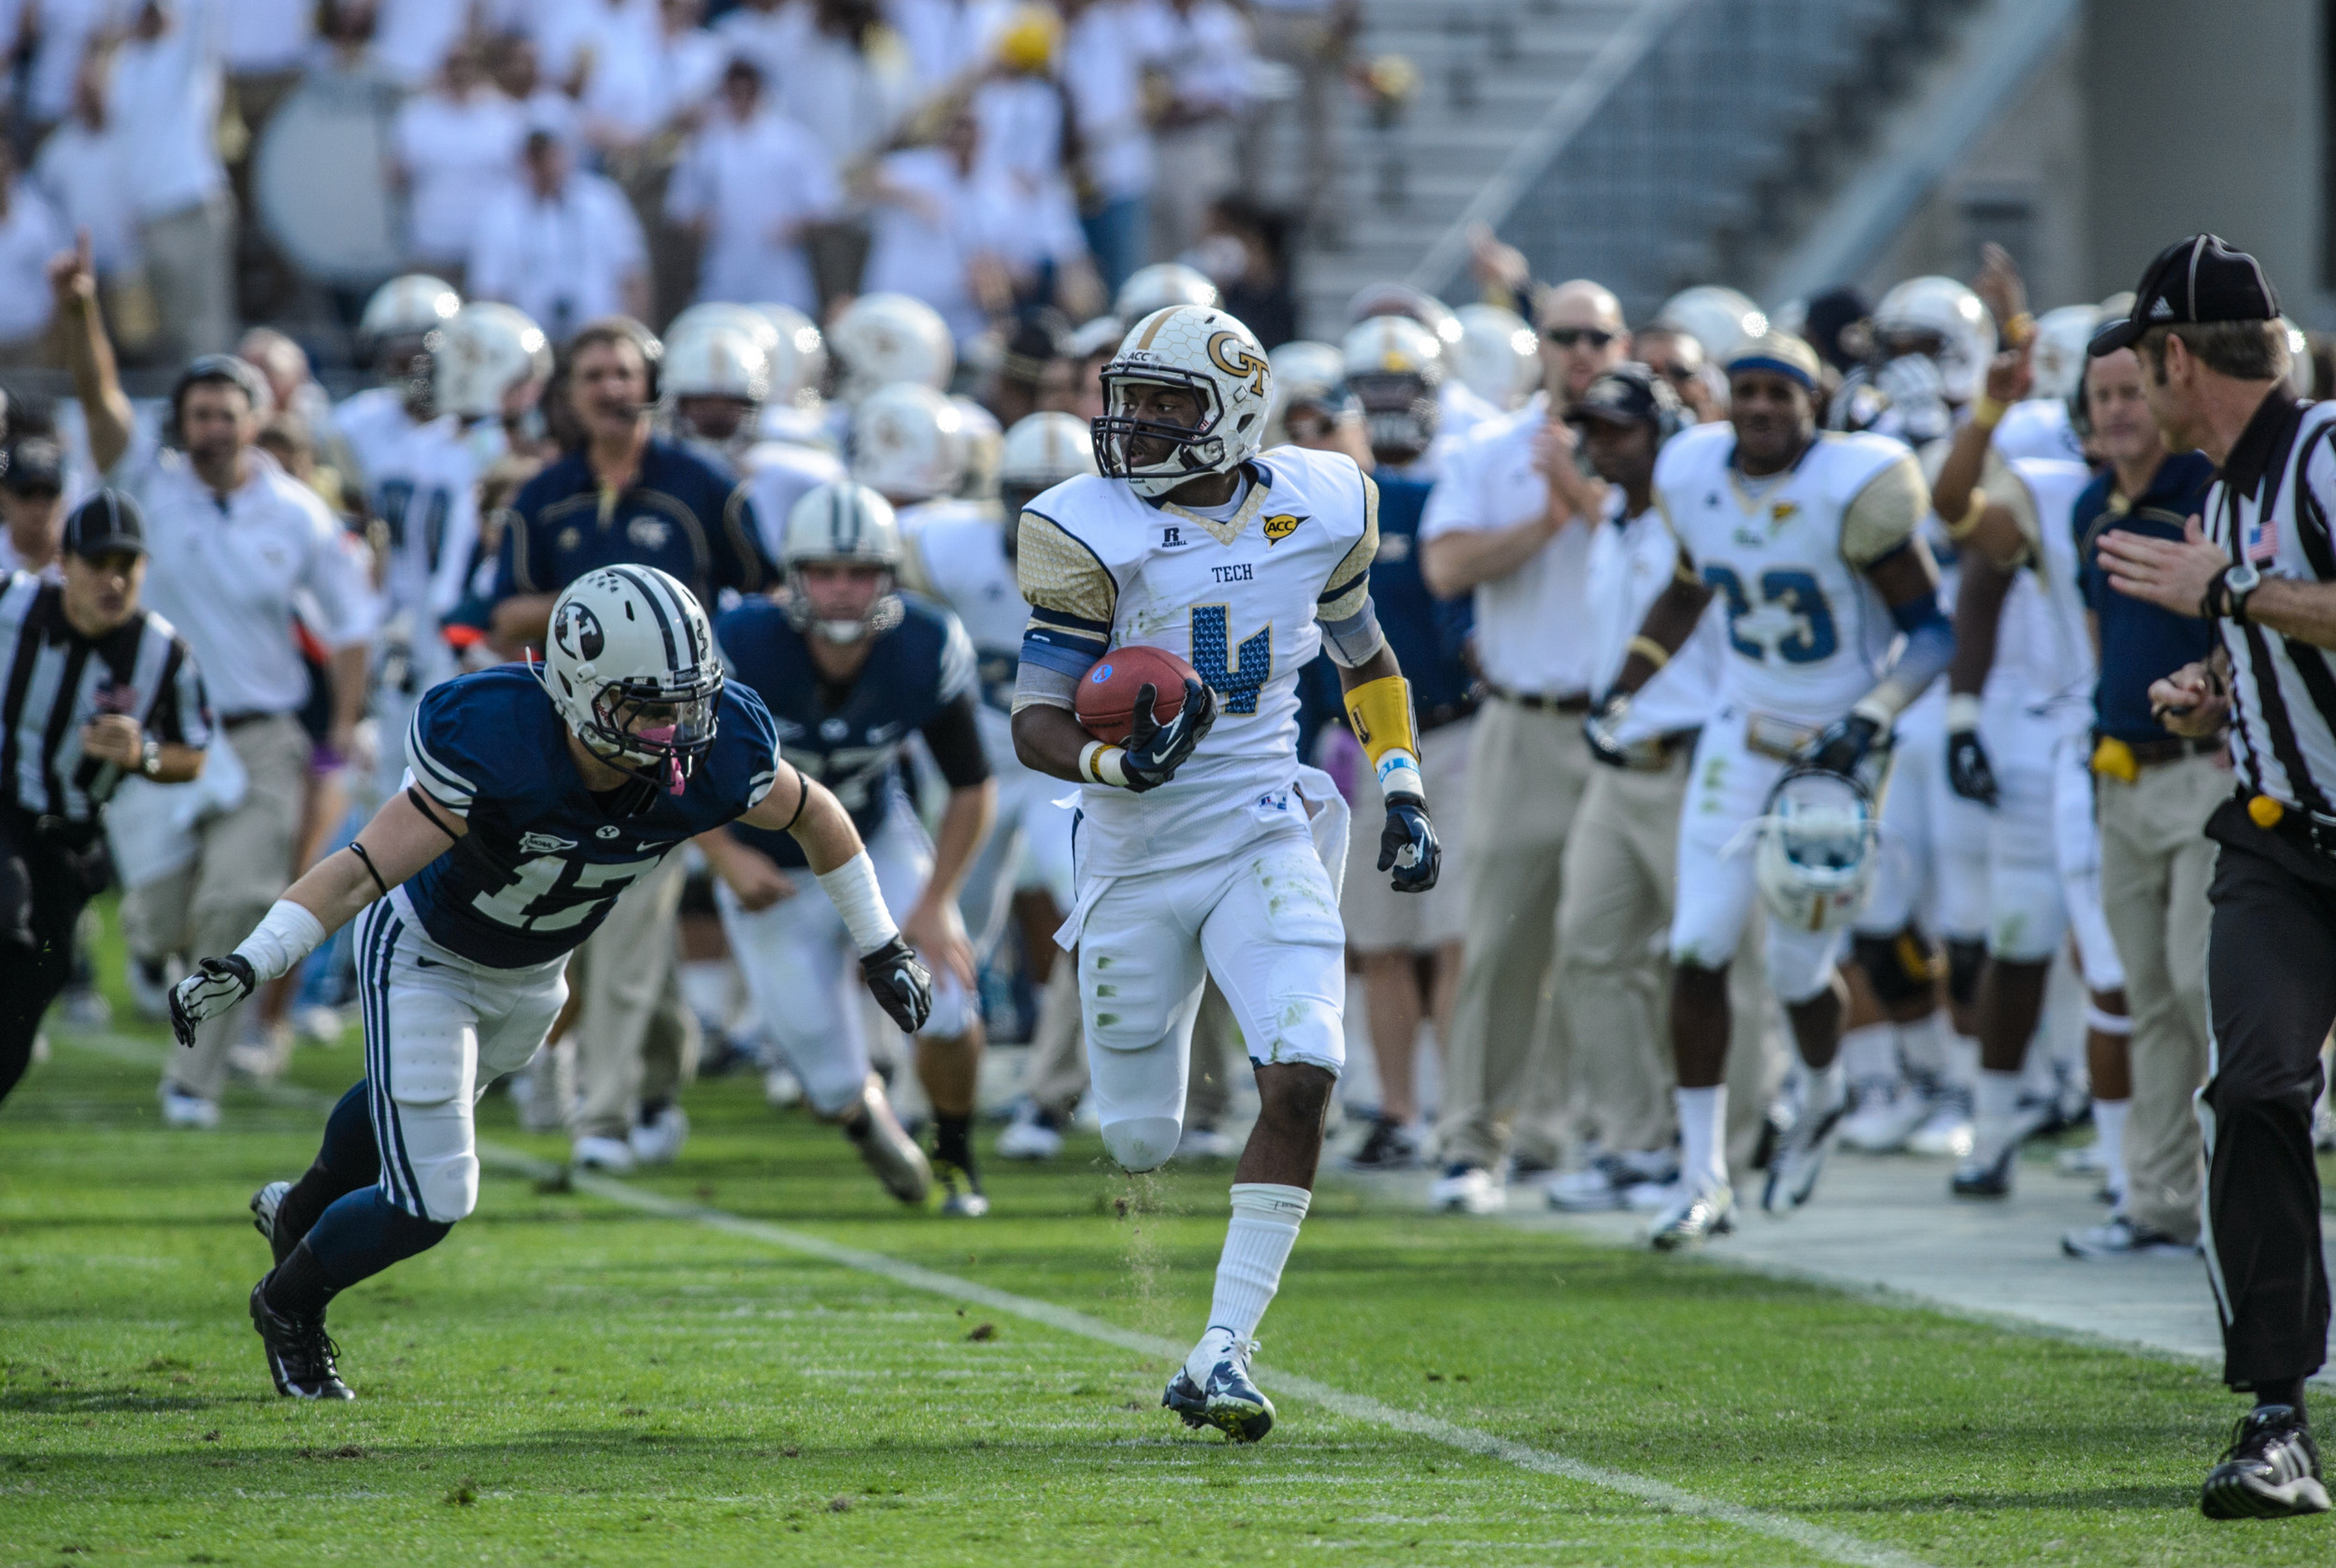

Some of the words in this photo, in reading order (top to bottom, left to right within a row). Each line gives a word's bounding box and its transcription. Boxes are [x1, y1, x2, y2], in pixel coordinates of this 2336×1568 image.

[1127, 351, 1152, 362] ACC
[1207, 330, 1271, 397] GT
[1164, 527, 1179, 542] R
[1266, 520, 1294, 533] ACC
[1161, 540, 1188, 549] RUSSELL
[1211, 563, 1254, 583] TECH
[1703, 565, 1839, 663] 23
[1189, 602, 1274, 718] 4
[601, 828, 619, 837] Y
[471, 854, 660, 932] 17
